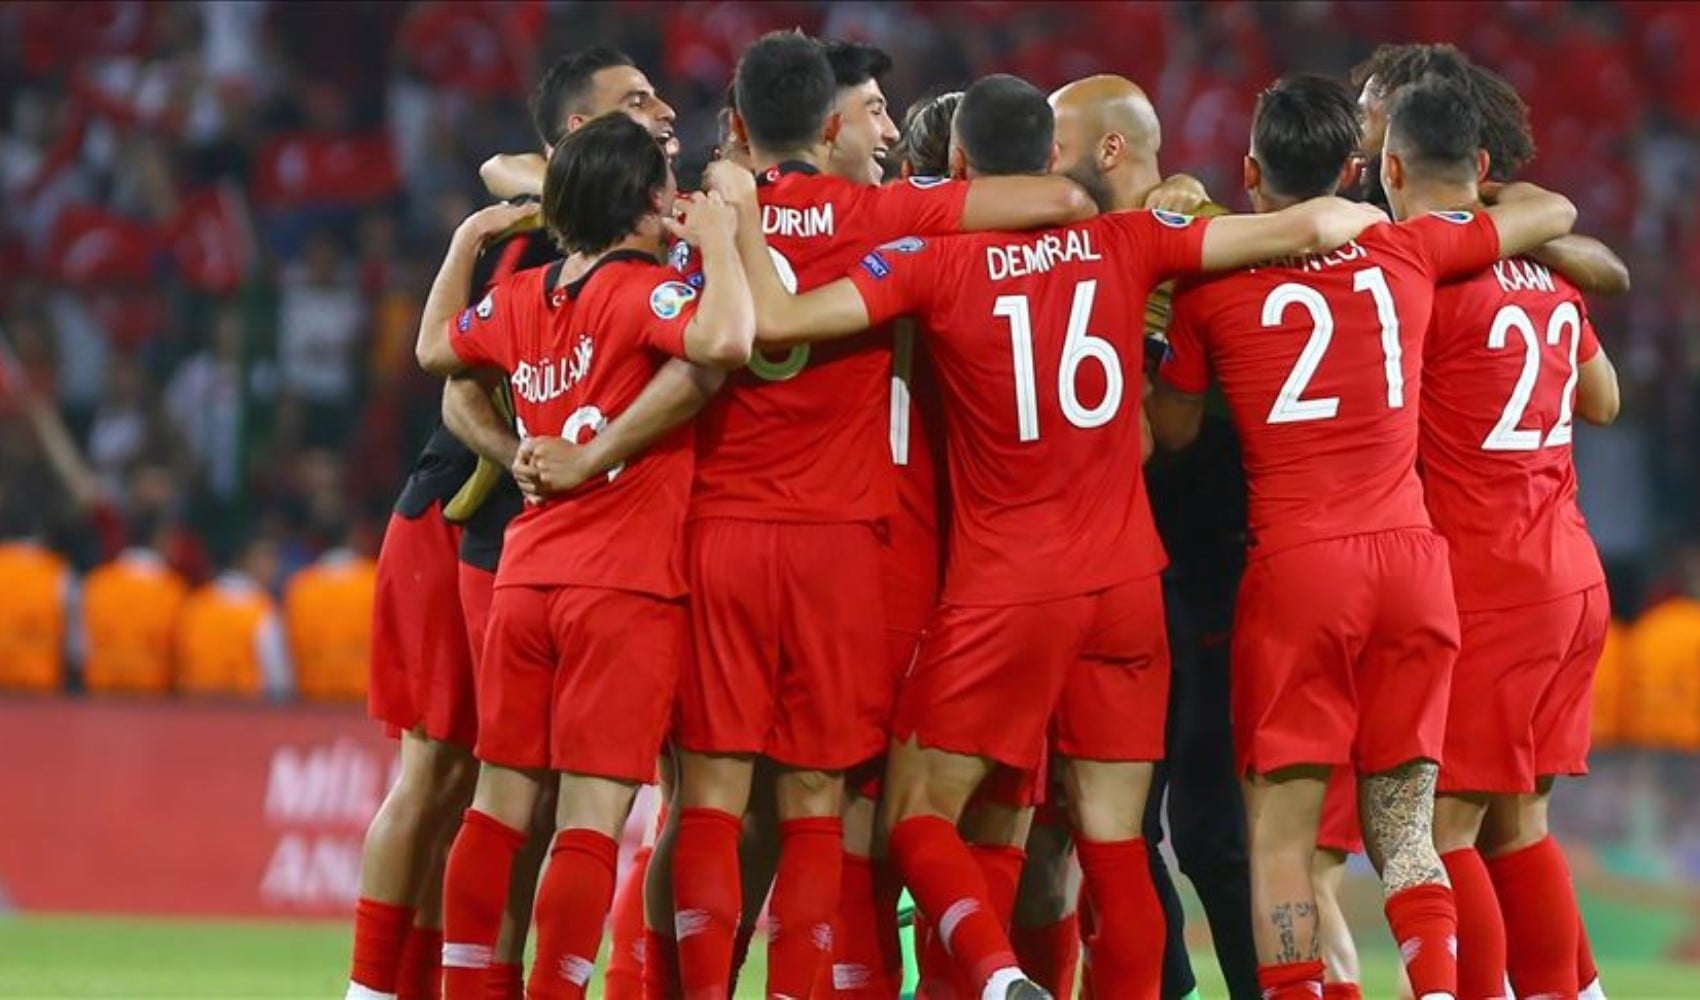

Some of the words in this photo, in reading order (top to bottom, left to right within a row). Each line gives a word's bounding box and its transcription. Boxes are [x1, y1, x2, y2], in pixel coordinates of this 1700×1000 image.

[762, 202, 834, 237] DIRIM
[1493, 260, 1556, 293] KAAN
[993, 280, 1125, 442] 16
[1261, 267, 1404, 424] 21
[1481, 302, 1581, 450] 22
[264, 738, 402, 824] MİL
[258, 833, 362, 904] AN
